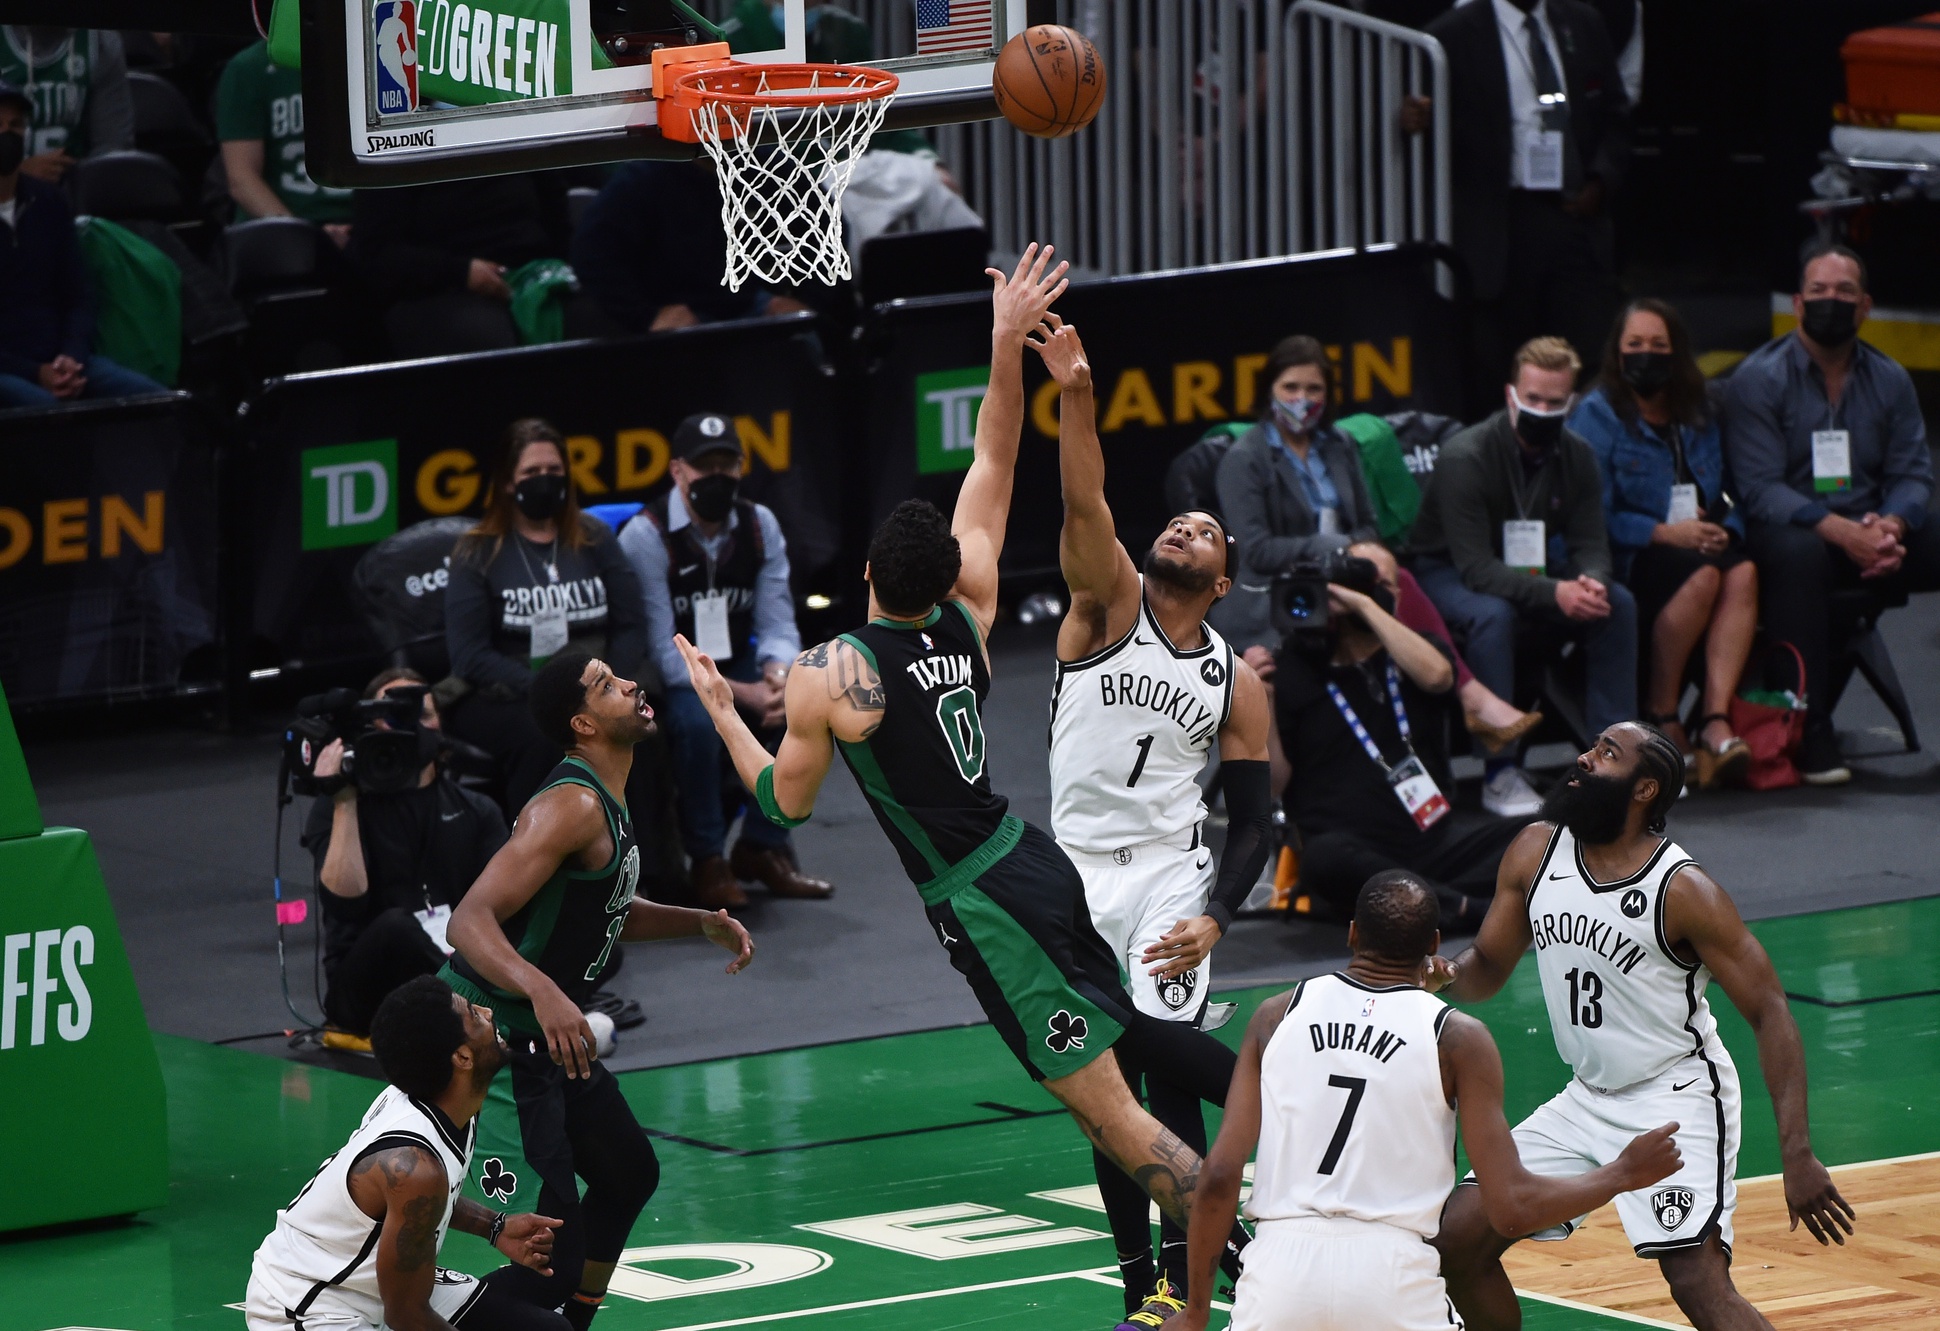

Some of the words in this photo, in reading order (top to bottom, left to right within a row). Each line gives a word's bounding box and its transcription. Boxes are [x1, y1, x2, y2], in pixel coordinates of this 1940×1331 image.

[382, 90, 402, 109] NBA
[367, 129, 435, 154] SPALDING
[311, 460, 389, 527] TD
[415, 411, 791, 515] GRDN
[906, 655, 972, 691] TATUM
[936, 685, 985, 785] 0
[1101, 673, 1215, 746] BROOKLYN
[1126, 734, 1154, 788] 1
[1533, 912, 1647, 975] BROOKLYN
[1, 925, 95, 1049] FFS
[1564, 967, 1603, 1029] 13
[1309, 1022, 1407, 1064] DURANT
[1317, 1074, 1367, 1175] 7
[1654, 1190, 1691, 1211] NETS
